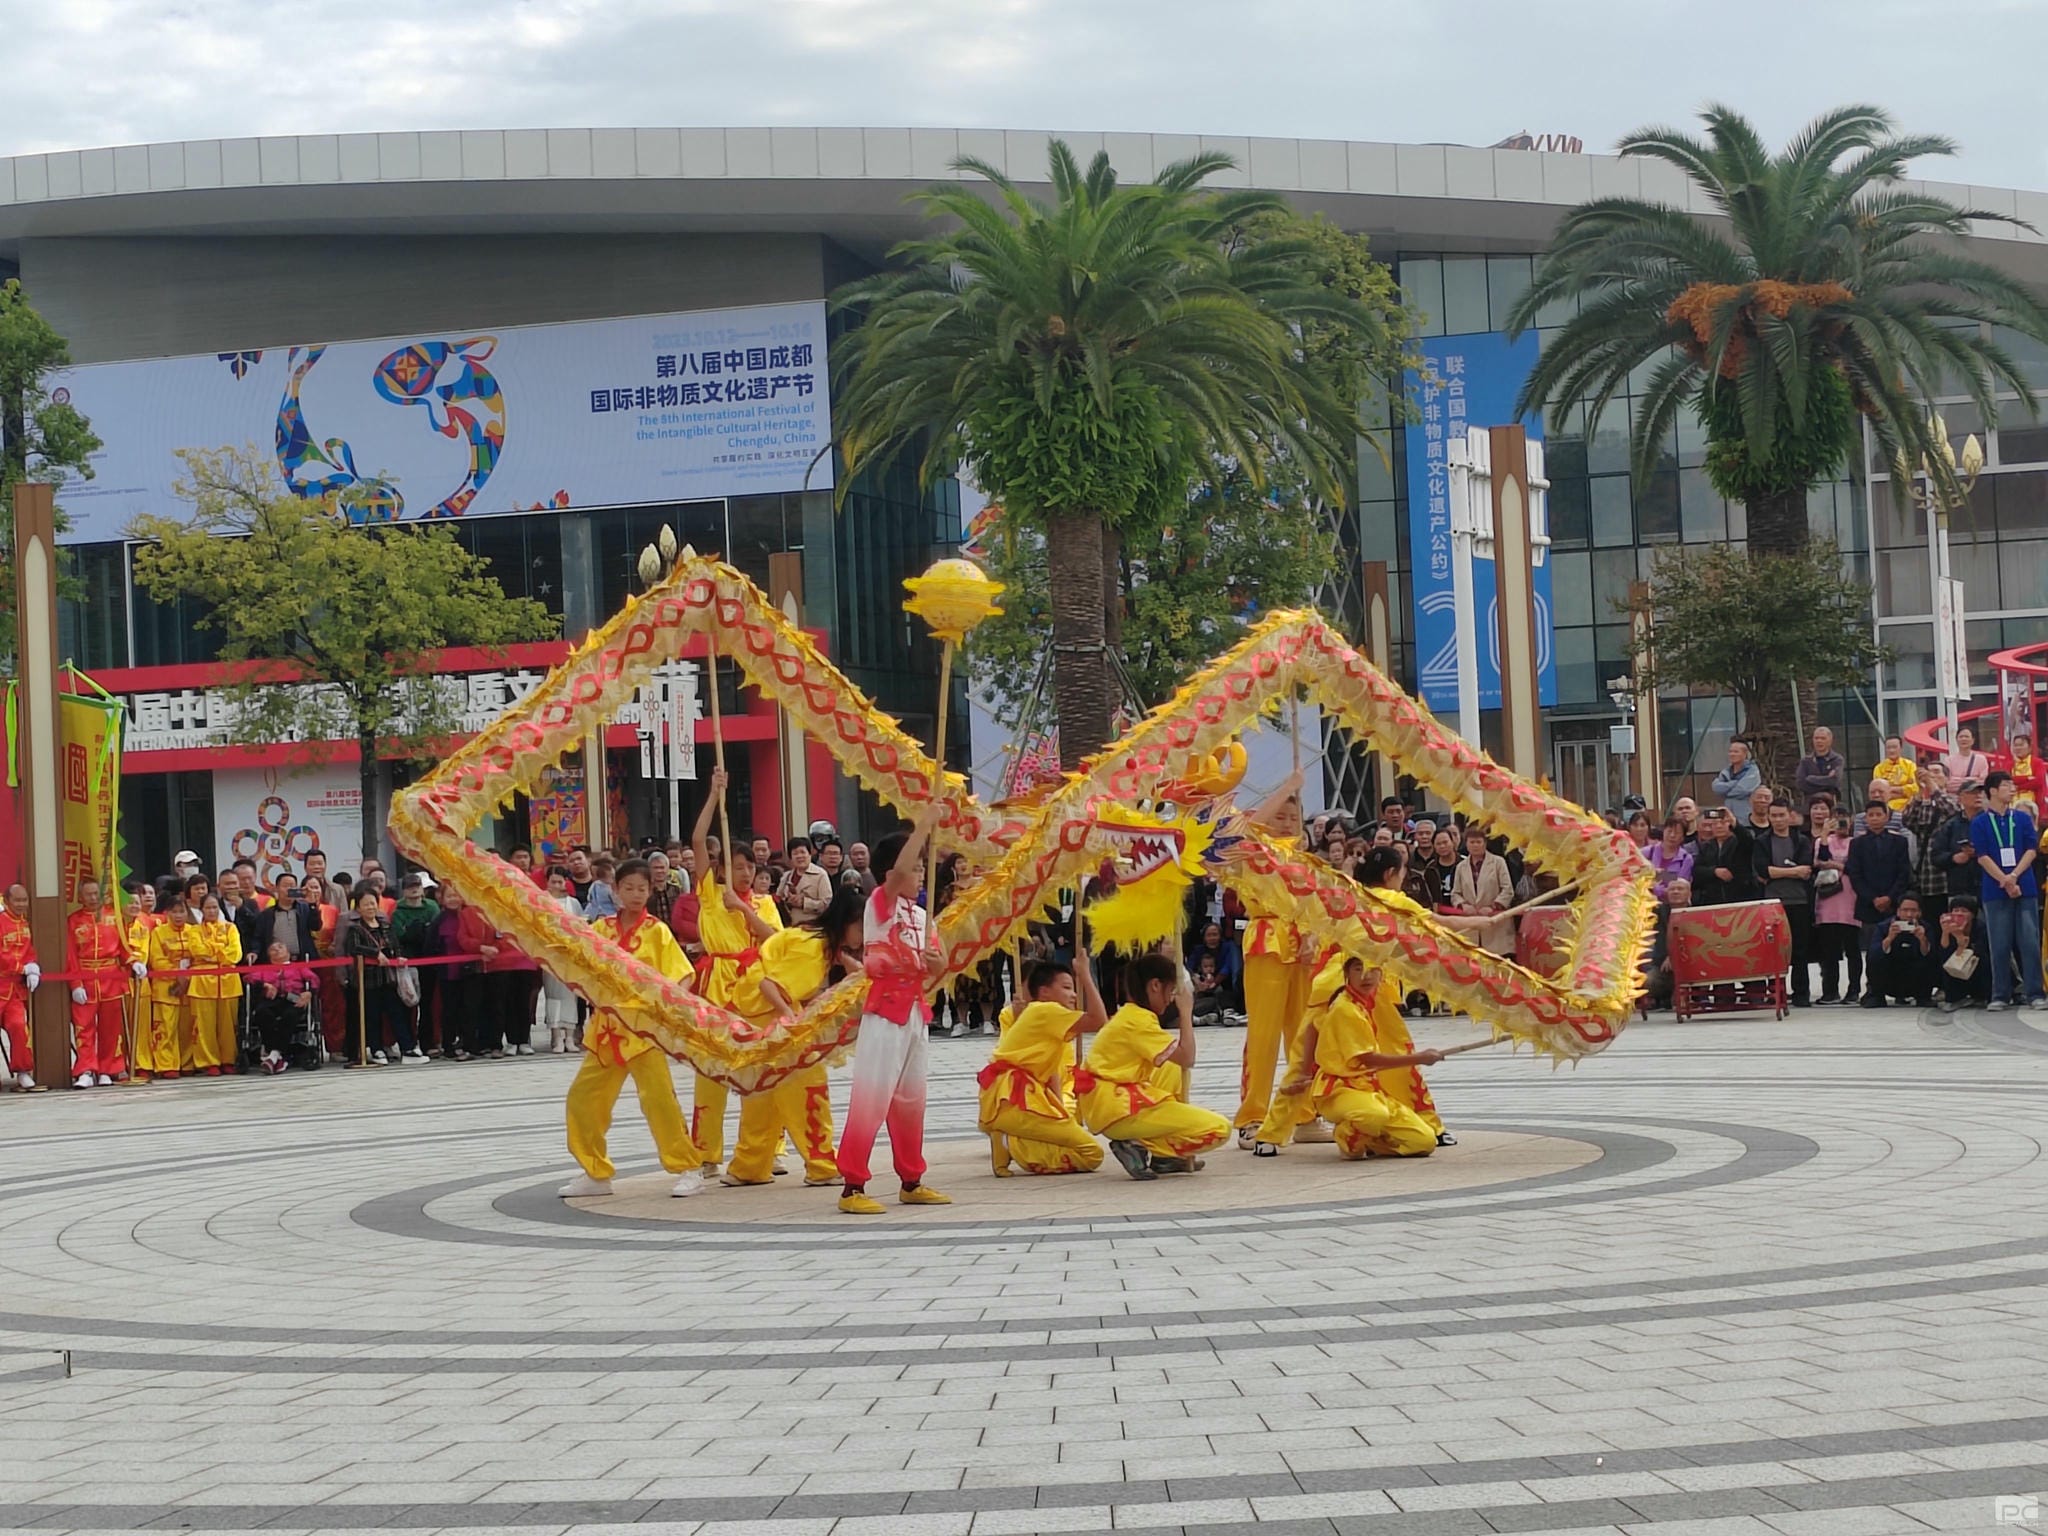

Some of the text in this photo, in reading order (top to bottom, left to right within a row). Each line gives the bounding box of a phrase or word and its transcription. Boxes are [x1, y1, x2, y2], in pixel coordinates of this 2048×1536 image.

[656, 344, 813, 379] 第八届中国成都
[591, 373, 815, 413] 国际非物质文化遗产节
[638, 402, 815, 427] The 8th International Festival of
[636, 417, 816, 441] the Intangible Cultural Heritage,
[727, 431, 816, 449] Chengdu, China
